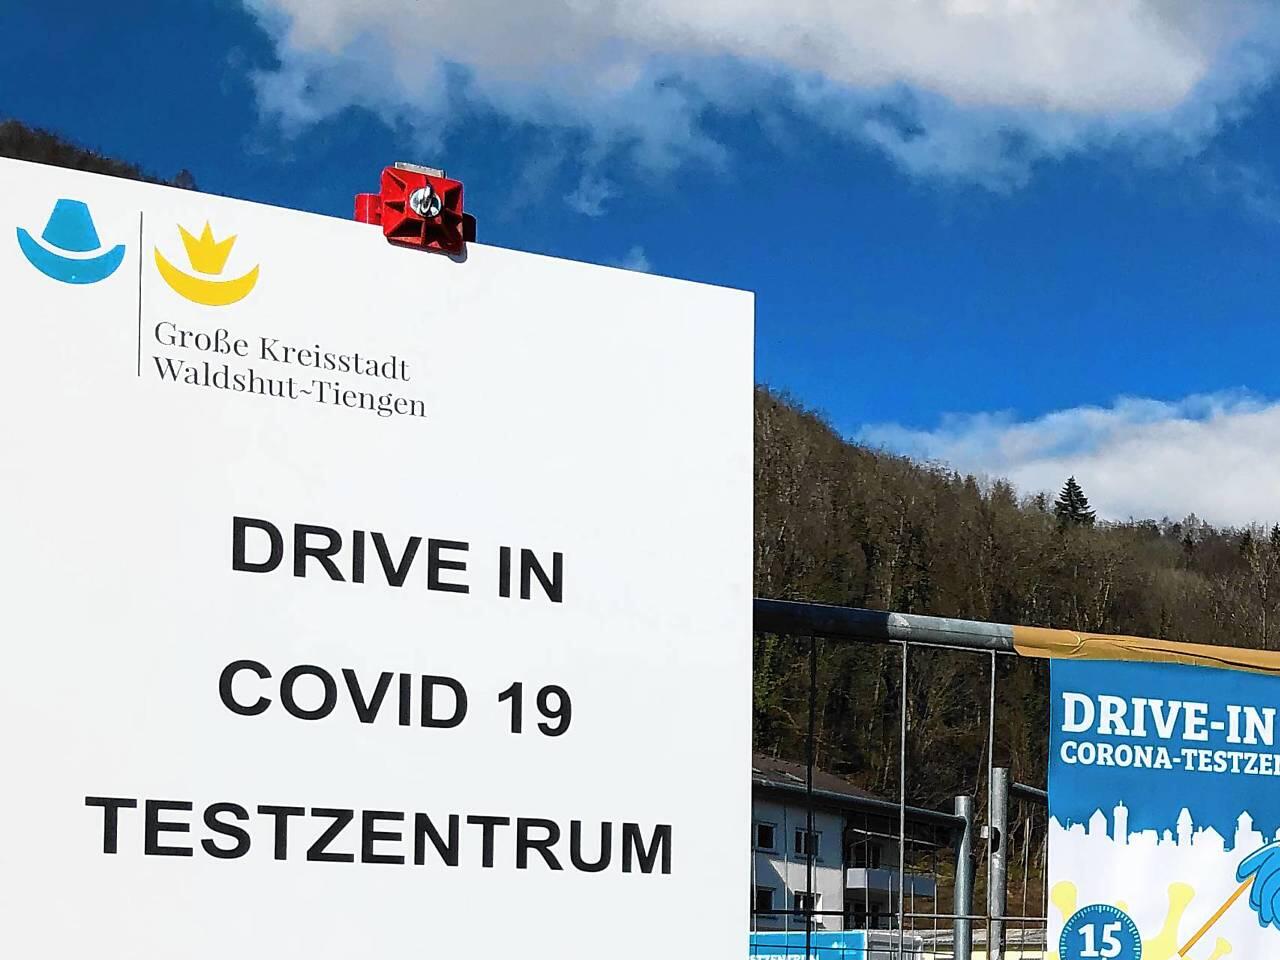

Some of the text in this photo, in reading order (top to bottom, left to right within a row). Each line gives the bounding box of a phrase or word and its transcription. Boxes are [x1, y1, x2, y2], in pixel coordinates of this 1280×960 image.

[153, 321, 411, 382] Große Kreisstadt
[232, 515, 564, 604] DRIVE IN
[218, 659, 573, 737] COVID 19
[1062, 691, 1277, 745] DRIVE-IN
[84, 795, 673, 875] TESTZENTRUM
[1078, 921, 1122, 957] 15
